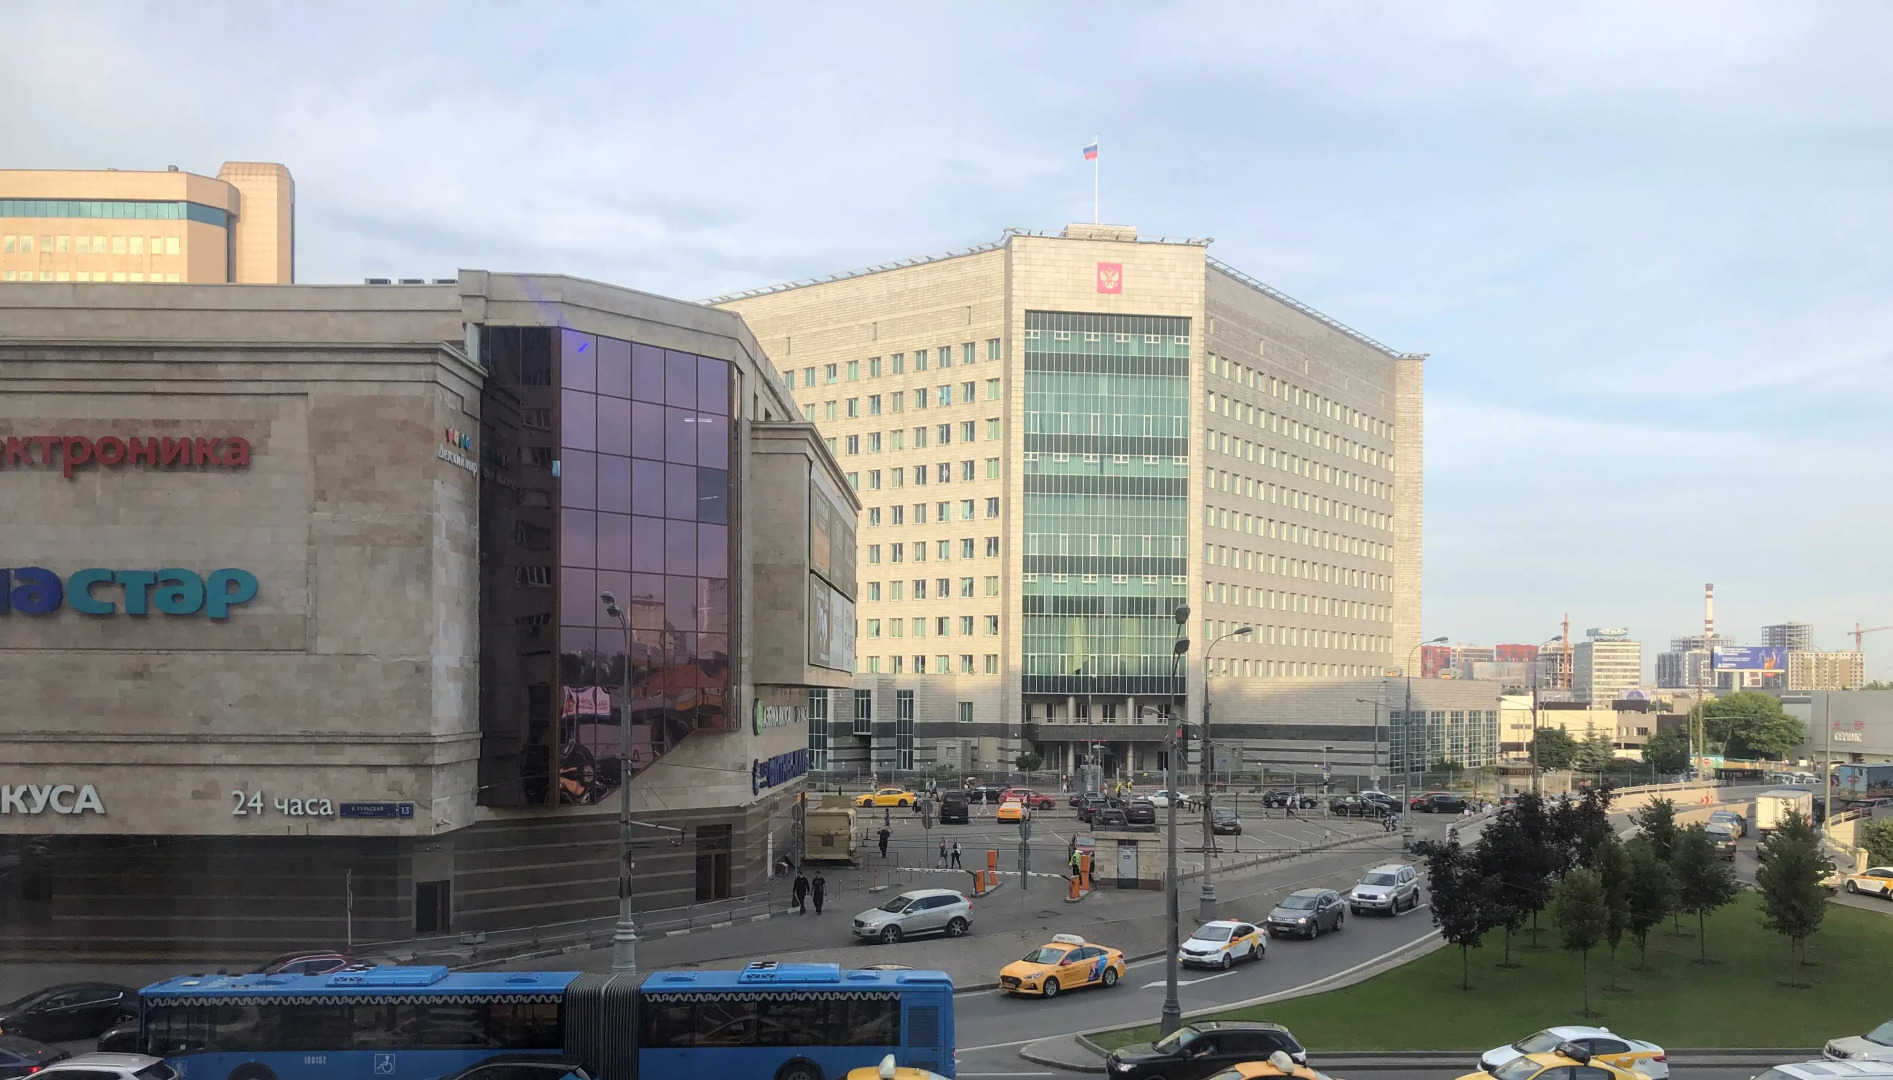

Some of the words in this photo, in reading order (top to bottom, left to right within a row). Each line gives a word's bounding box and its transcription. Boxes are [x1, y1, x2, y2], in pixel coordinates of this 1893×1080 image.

[0, 436, 250, 478] ктроника
[1, 784, 106, 814] КУСА
[232, 790, 264, 815] 24
[274, 797, 334, 816] часа
